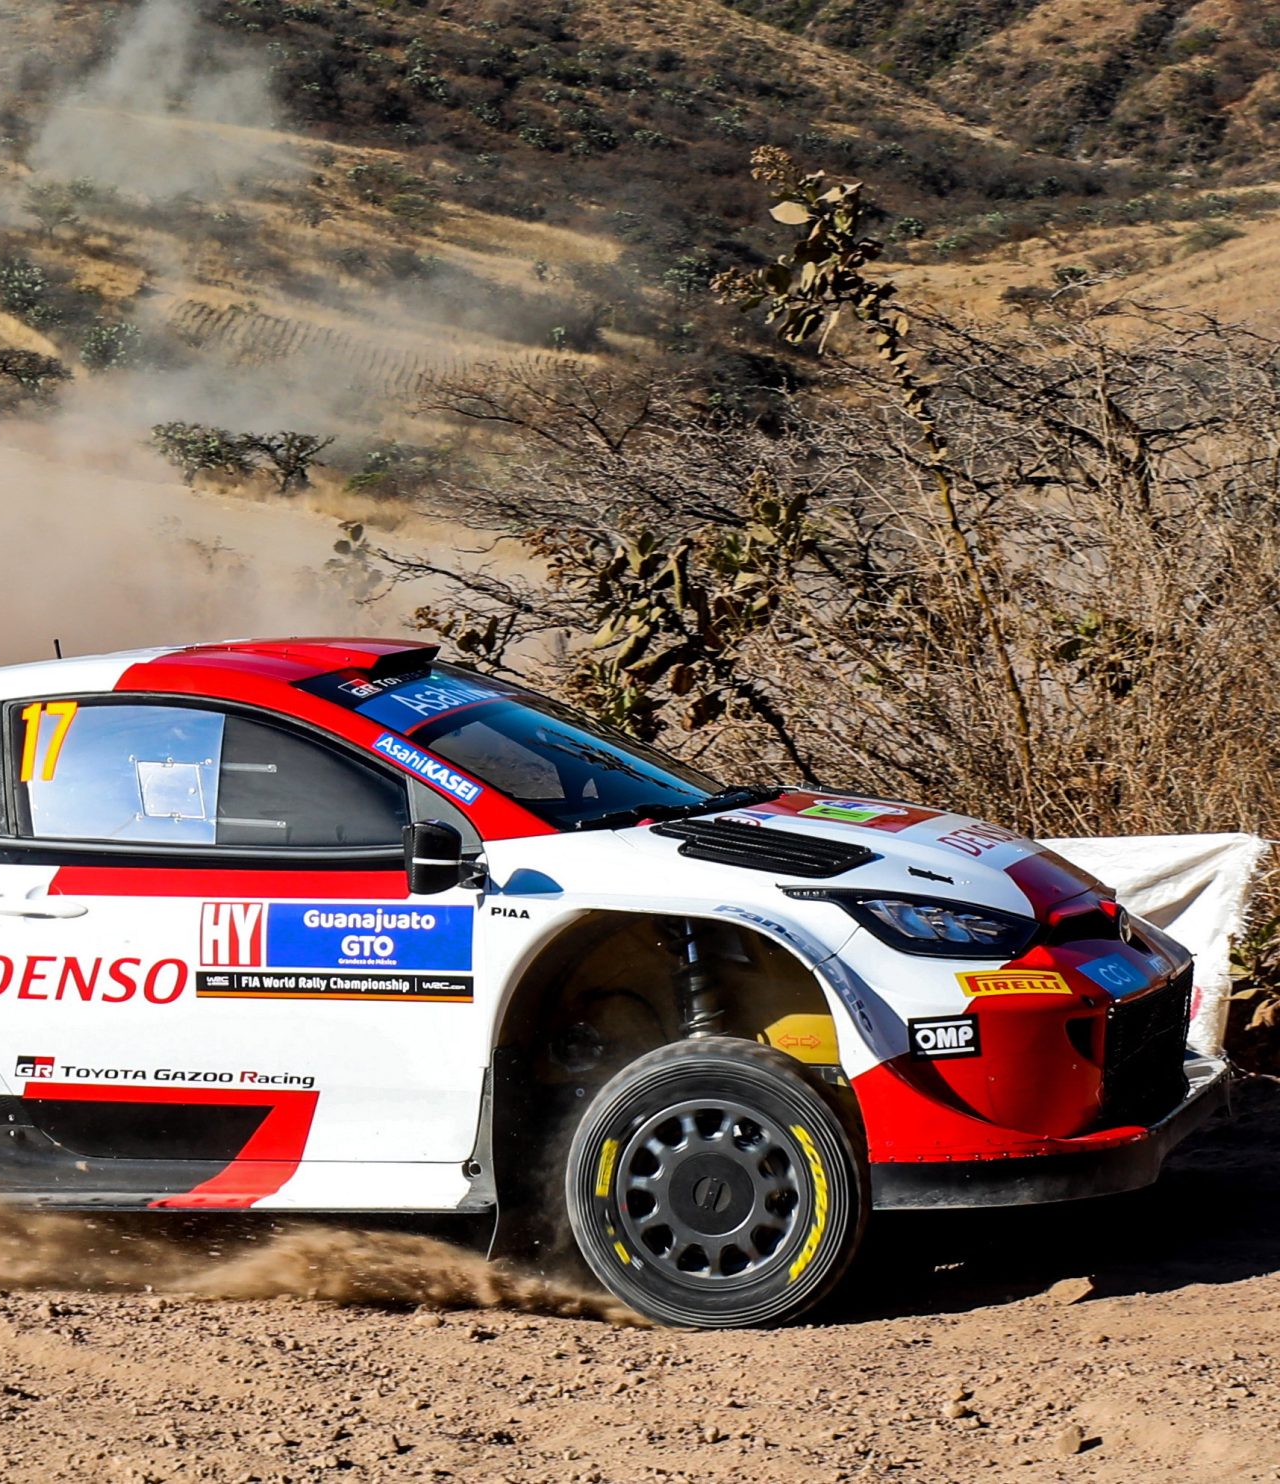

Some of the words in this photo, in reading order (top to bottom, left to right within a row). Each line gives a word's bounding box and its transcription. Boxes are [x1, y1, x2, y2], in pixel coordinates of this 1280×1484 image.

[20, 701, 78, 782] 17
[376, 736, 478, 801] AsahiKASEI
[302, 908, 436, 933] Guanajuato
[490, 906, 530, 919] PIAA
[201, 902, 262, 966] HY
[340, 935, 395, 958] GTO
[241, 975, 261, 988] FIA
[262, 976, 296, 989] World
[298, 976, 328, 991] Rally
[329, 977, 410, 993] Championship
[965, 973, 1062, 993] PIRELLI
[915, 1025, 974, 1050] OMP
[16, 1063, 53, 1079] GR
[60, 1065, 147, 1081] TOYOTA
[153, 1068, 234, 1084] GAZOO
[239, 1070, 316, 1089] Racing
